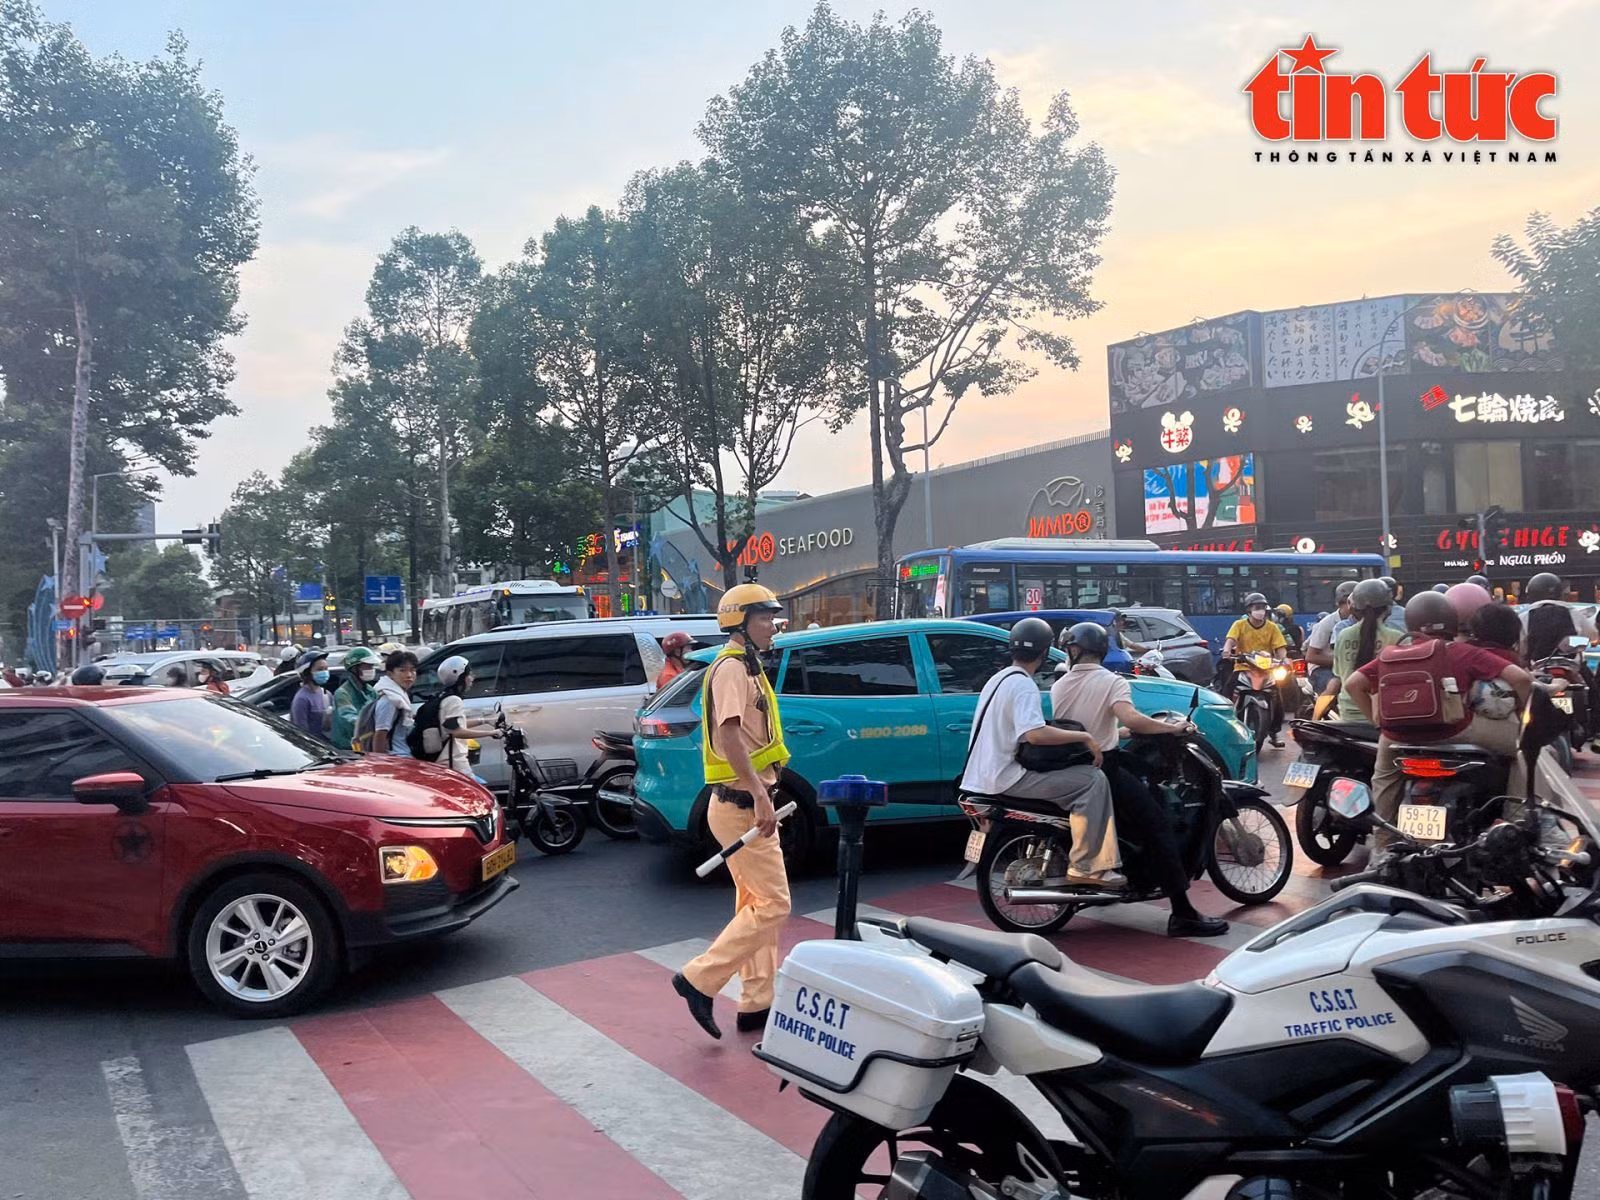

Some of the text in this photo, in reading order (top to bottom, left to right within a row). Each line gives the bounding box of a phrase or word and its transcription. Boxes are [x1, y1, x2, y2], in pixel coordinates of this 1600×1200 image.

[779, 527, 853, 556] SEAFOOD
[1027, 589, 1041, 604] 30
[1406, 807, 1440, 822] 59-T2
[1402, 822, 1441, 837] 449.81
[1515, 932, 1567, 945] POLICE
[796, 986, 851, 1030] C.S.G.T
[1309, 989, 1358, 1013] C.S.G.T
[774, 1010, 857, 1061] TRAFFIC POLICE
[1284, 1012, 1396, 1038] TRAFFIC POLICE
[1503, 1034, 1566, 1053] HONDA
